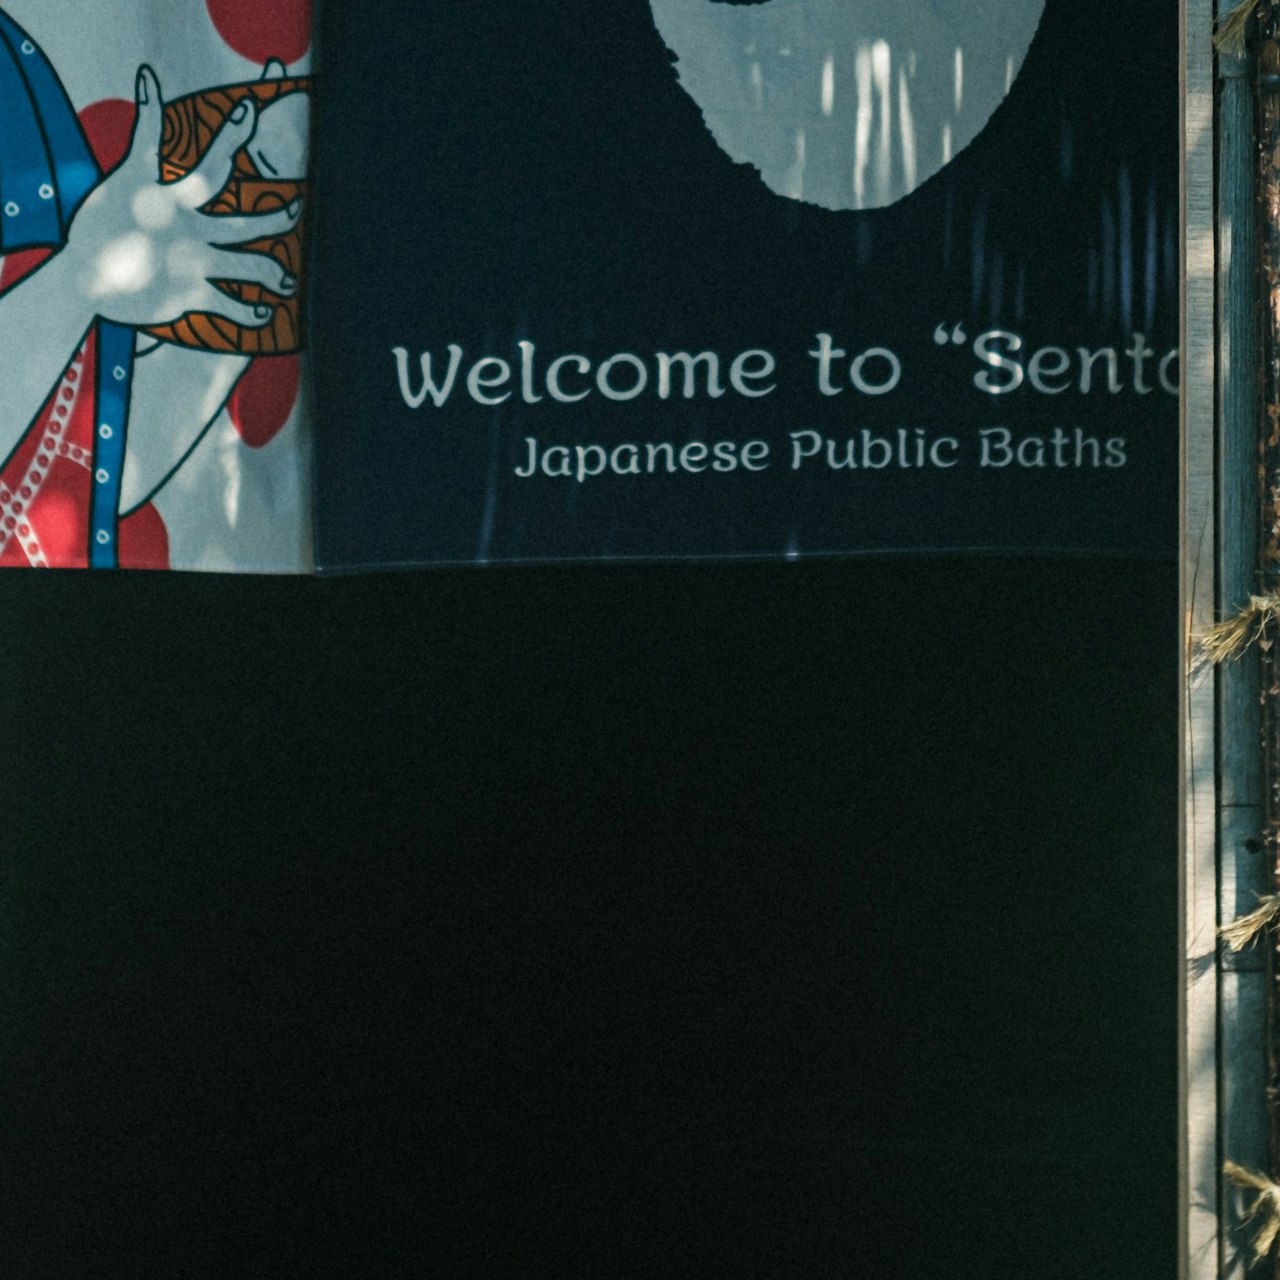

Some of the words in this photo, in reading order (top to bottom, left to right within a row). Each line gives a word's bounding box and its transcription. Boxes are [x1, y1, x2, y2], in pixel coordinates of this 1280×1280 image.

[392, 341, 777, 408] Welcome
[809, 333, 901, 396] to
[515, 437, 770, 482] Japanese
[790, 428, 959, 470] Public
[979, 426, 1127, 469] Baths
